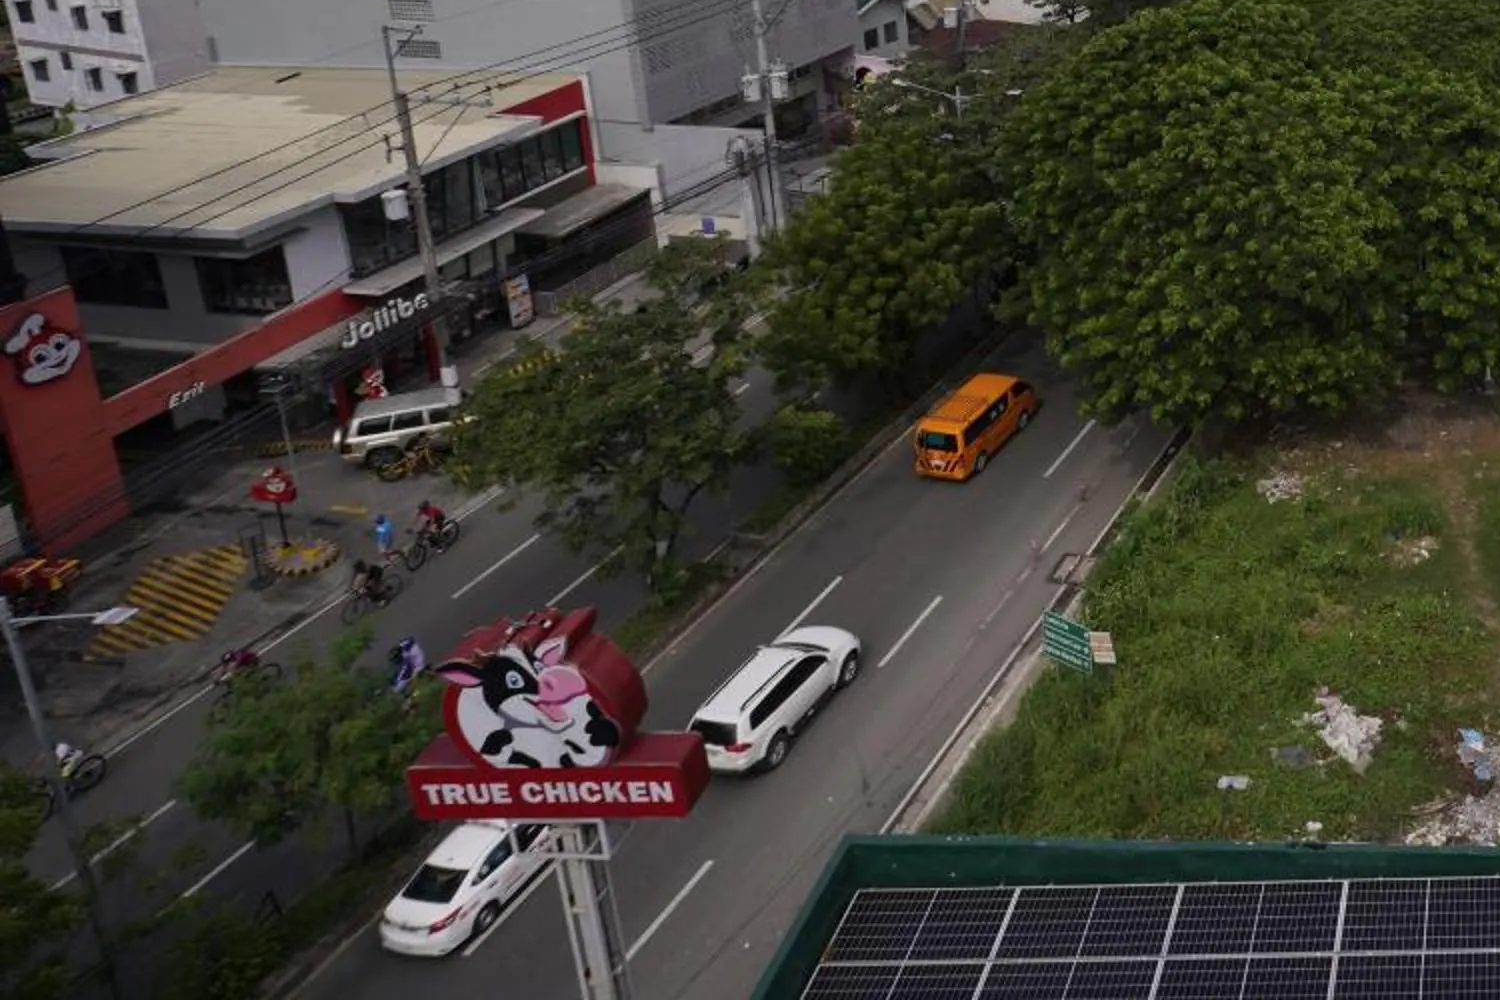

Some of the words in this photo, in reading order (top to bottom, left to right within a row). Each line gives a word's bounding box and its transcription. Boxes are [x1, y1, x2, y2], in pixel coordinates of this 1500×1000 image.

[341, 292, 430, 349] Jollibe
[421, 783, 512, 805] TRUE
[520, 781, 675, 804] CHICKEN
